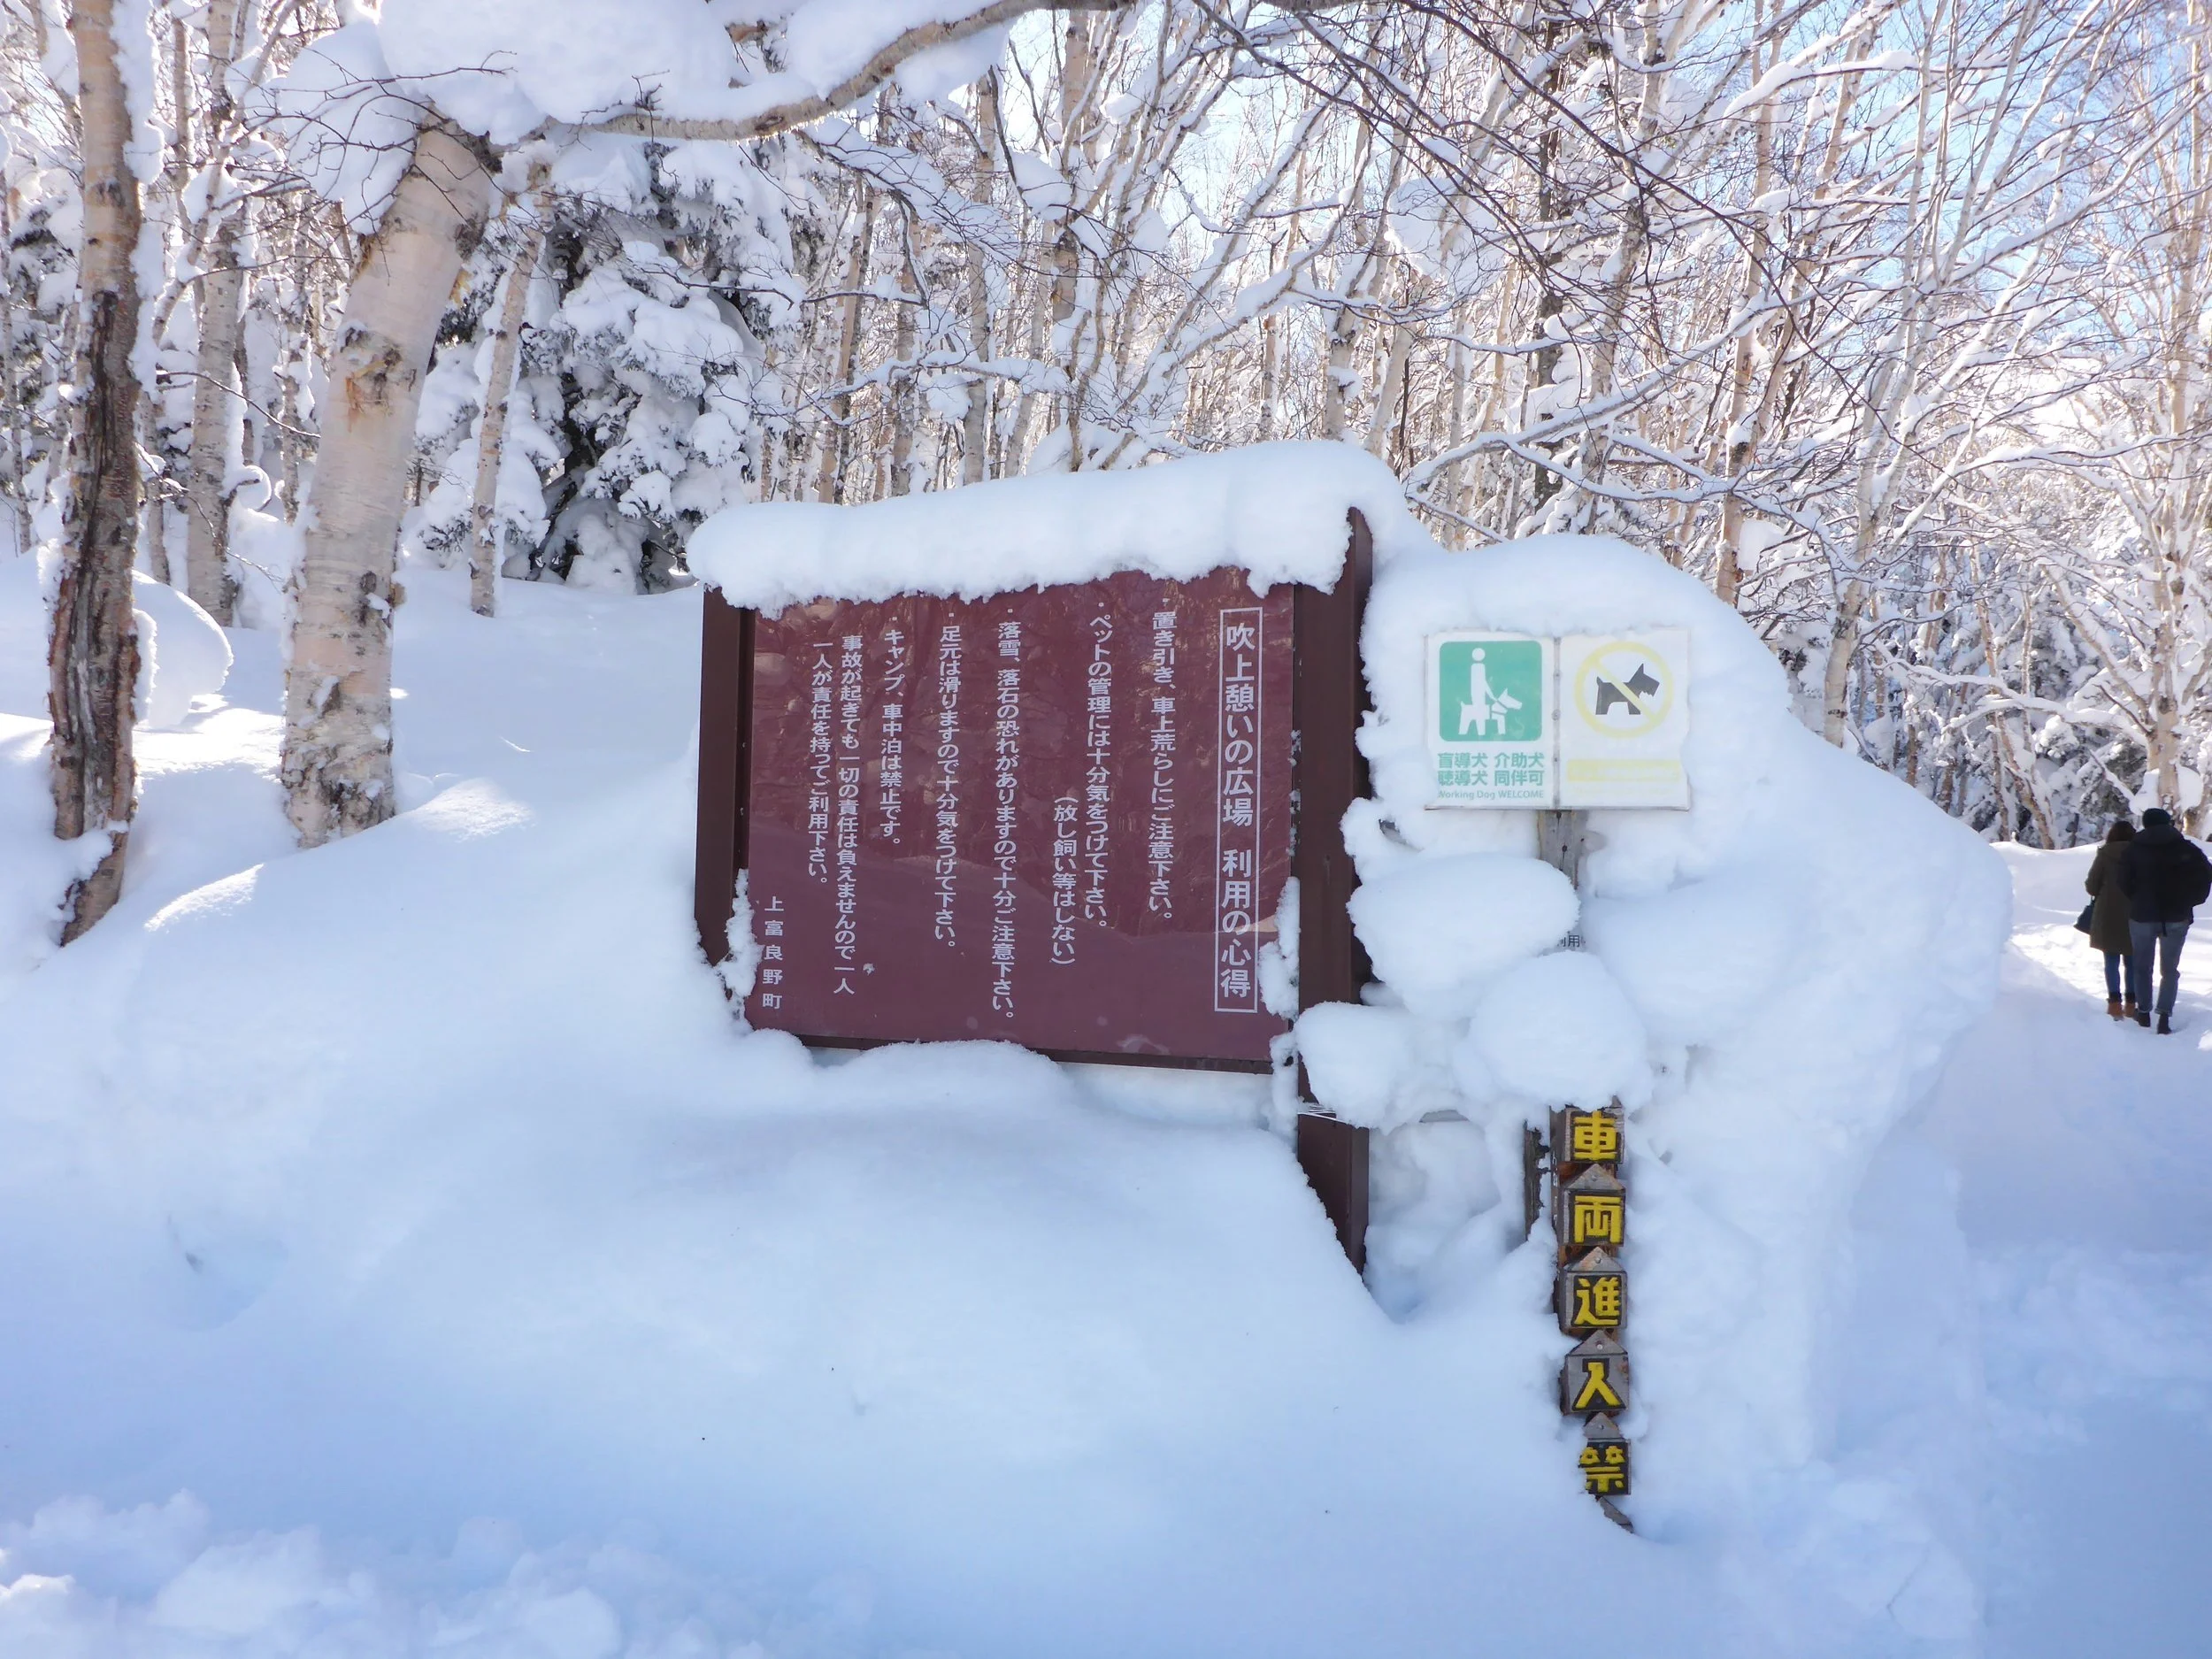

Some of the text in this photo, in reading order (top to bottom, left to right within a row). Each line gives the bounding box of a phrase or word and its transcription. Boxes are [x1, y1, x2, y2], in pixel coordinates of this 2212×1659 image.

[807, 641, 833, 885] 一人が責任を持ってご利用下さい。
[833, 634, 864, 995] 事故が起きても一切の責任は負えませんので一人
[1220, 622, 1256, 999] 吹上憩いの広場 利用の心得
[1437, 752, 1545, 769] 盲導犬 介助犬
[1437, 770, 1545, 787] 聴導犬 同伴可
[1477, 789, 1495, 800] Dog
[1498, 789, 1544, 798] WELCOME
[762, 895, 785, 1010] 上富良野町
